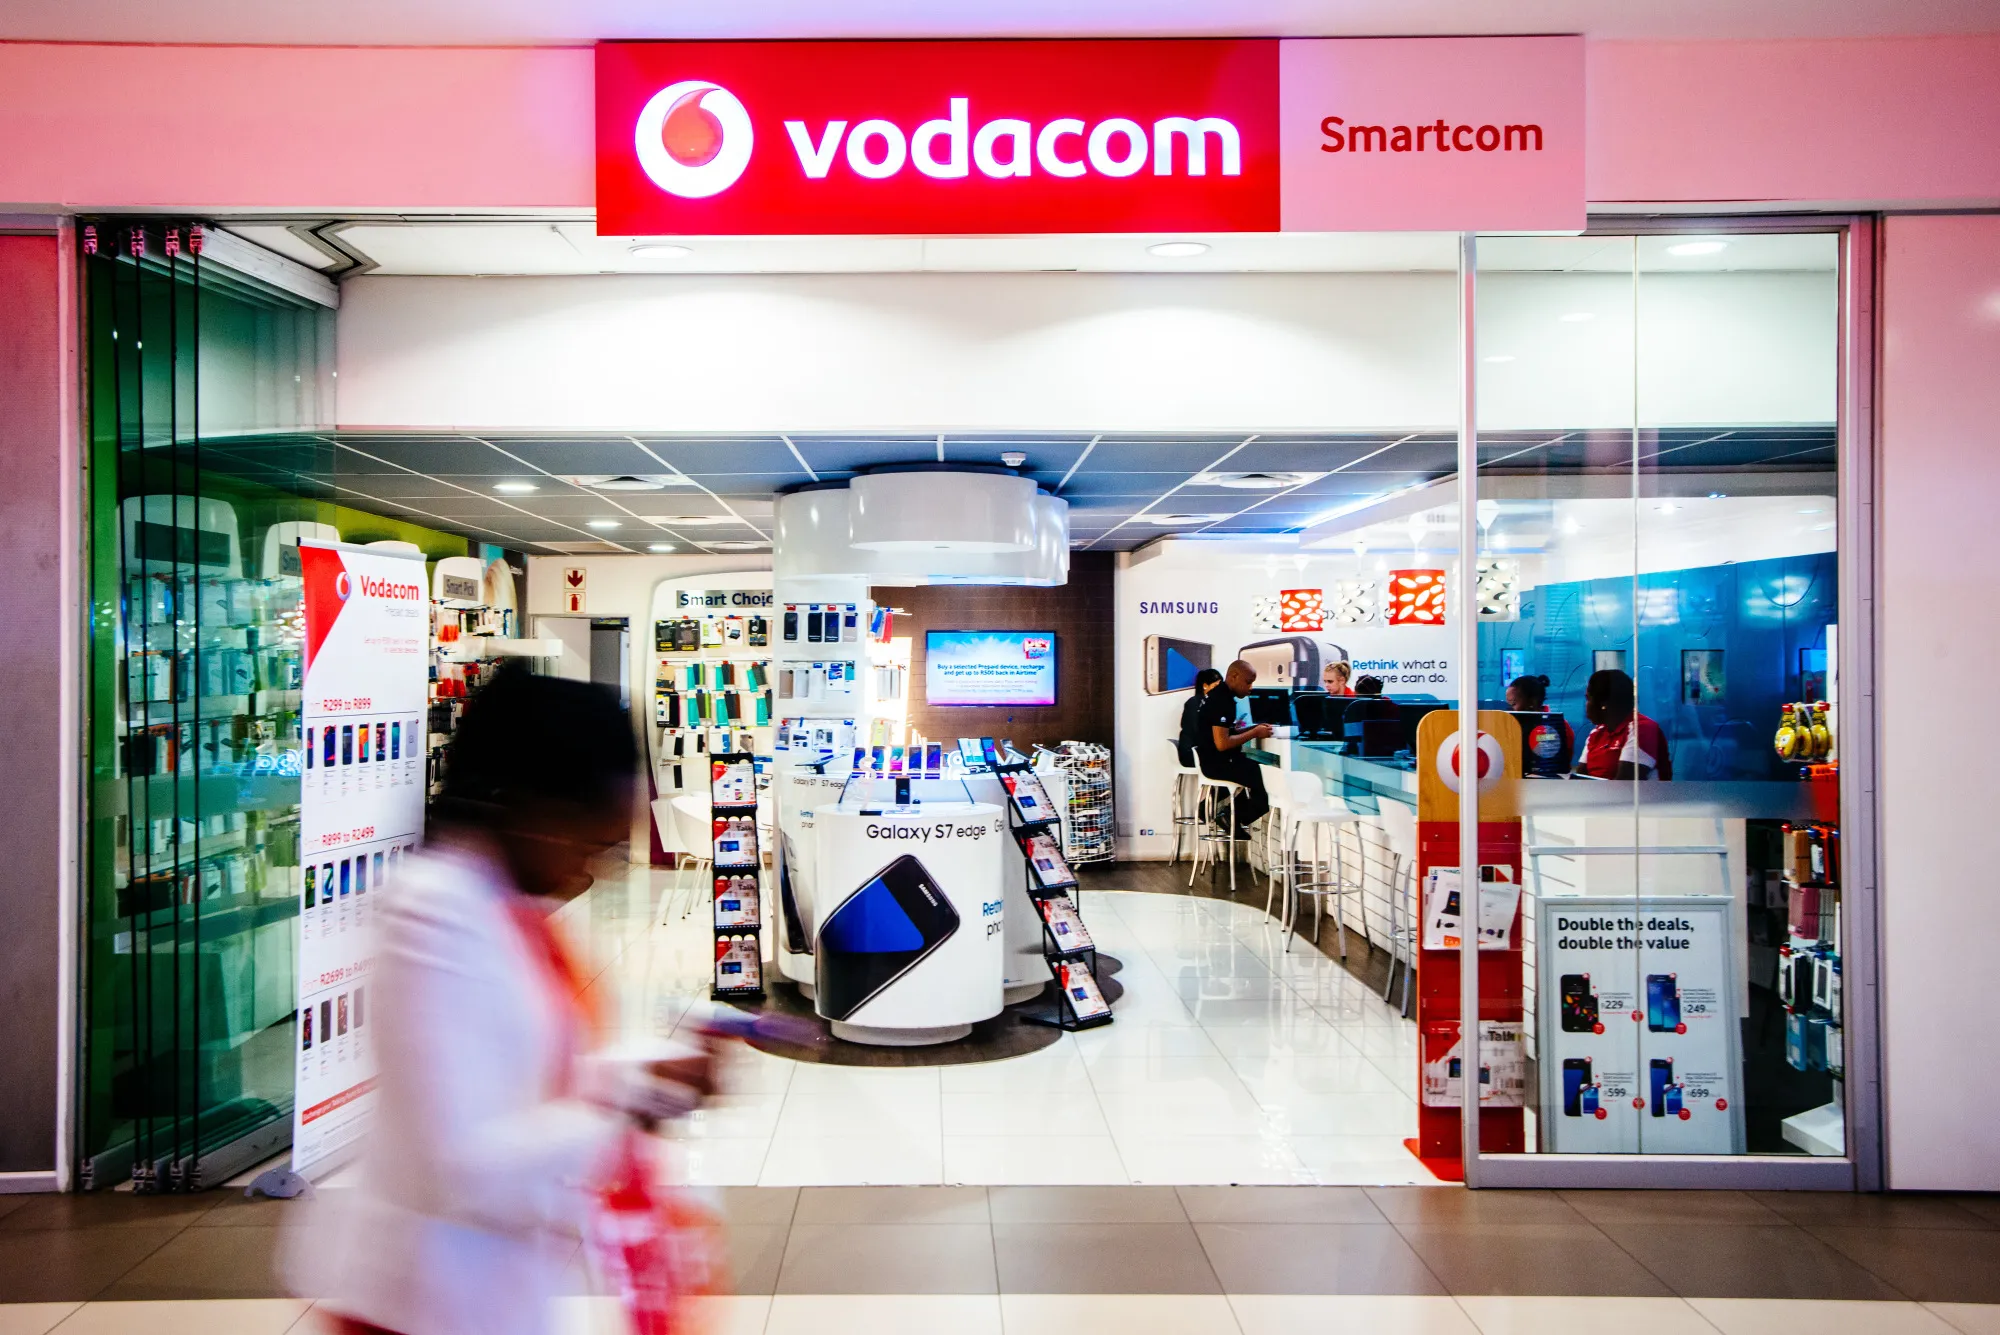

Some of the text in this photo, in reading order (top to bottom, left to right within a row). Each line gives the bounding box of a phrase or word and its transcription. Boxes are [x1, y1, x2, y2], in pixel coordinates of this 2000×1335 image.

[785, 97, 1241, 179] vodacom
[1320, 116, 1543, 154] Smartcom
[360, 575, 418, 600] Vodacom
[680, 593, 726, 606] Smart
[1140, 602, 1218, 614] SAMSUNG
[1353, 659, 1399, 670] Rethink
[1403, 660, 1435, 669] what
[1401, 674, 1424, 683] can
[1429, 673, 1447, 683] do.
[323, 699, 342, 711] R299
[344, 701, 351, 710] to
[343, 833, 350, 842] to
[866, 824, 986, 843] Galaxy S7 edge
[919, 883, 939, 907] SAMSUNG
[1558, 917, 1694, 932] Double the deals,
[1558, 936, 1690, 949] double the value
[320, 968, 344, 986] R2699
[346, 968, 352, 977] to
